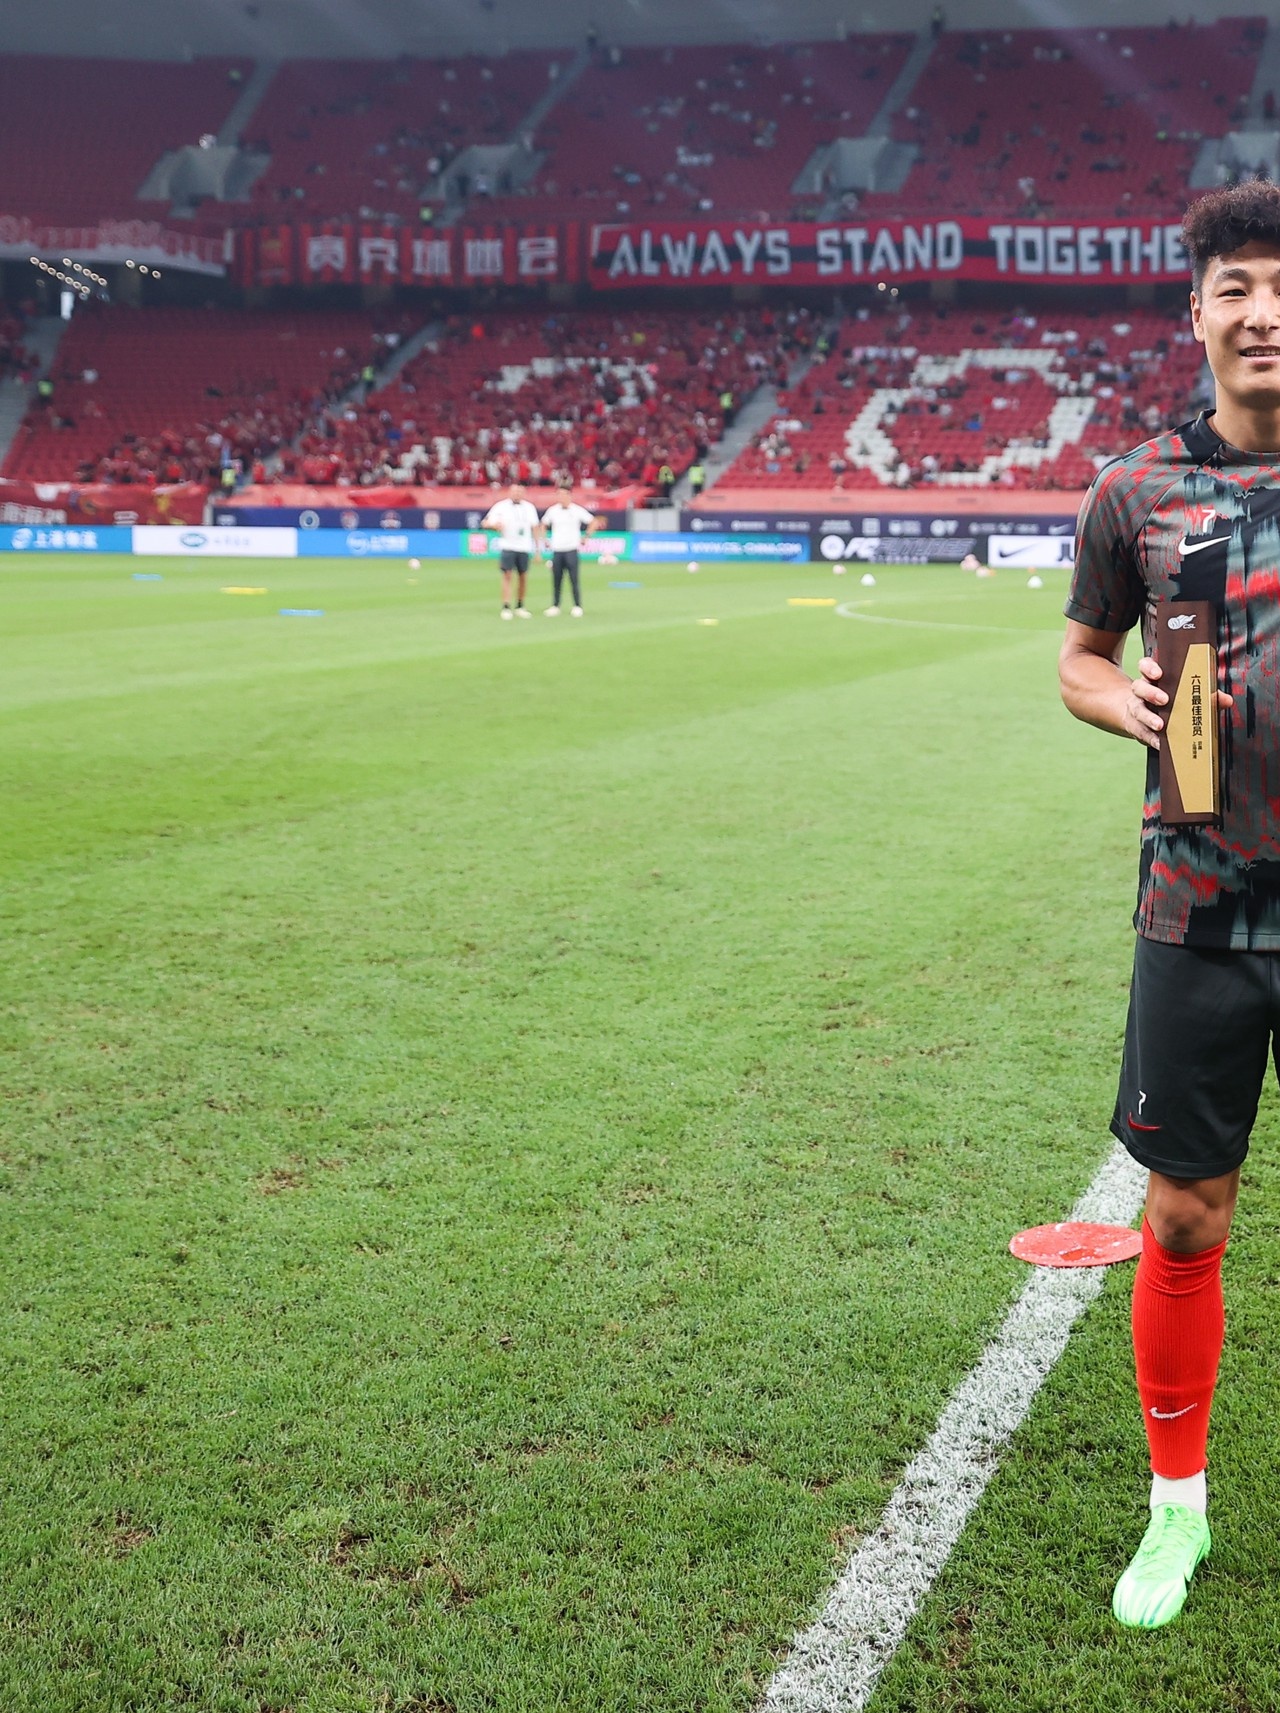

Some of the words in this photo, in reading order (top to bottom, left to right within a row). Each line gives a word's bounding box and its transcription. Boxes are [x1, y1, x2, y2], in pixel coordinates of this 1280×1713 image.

[607, 228, 792, 278] ALWAYS
[816, 221, 962, 275] STAND
[988, 223, 1192, 275] TOGETHE
[1202, 509, 1215, 533] 7
[1191, 674, 1203, 737] 六月最佳球员
